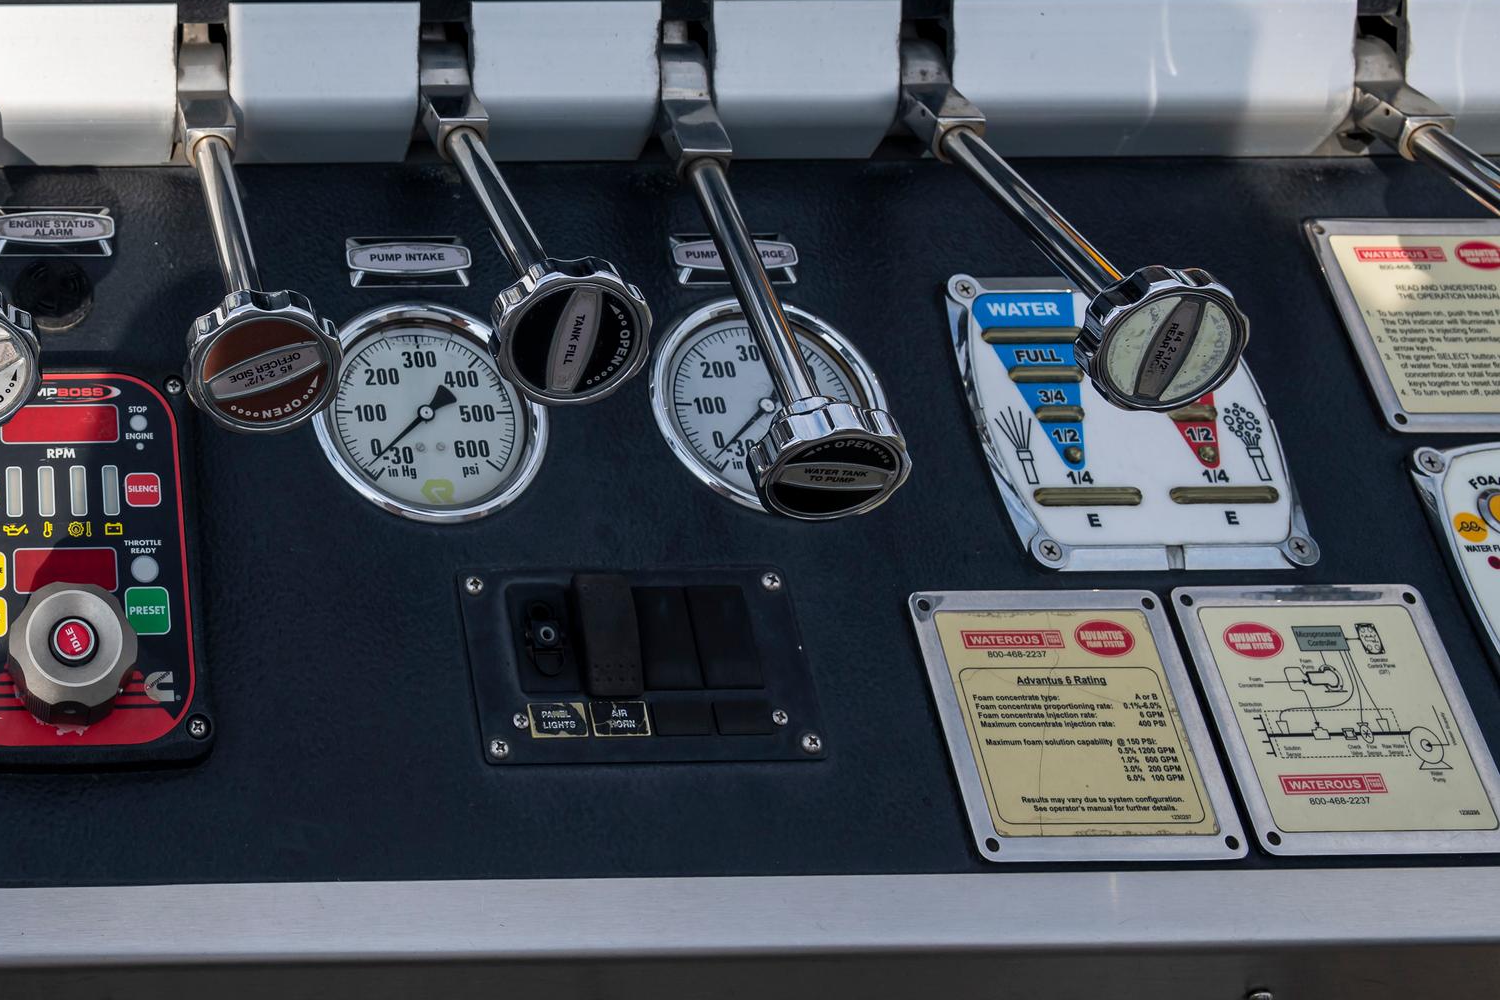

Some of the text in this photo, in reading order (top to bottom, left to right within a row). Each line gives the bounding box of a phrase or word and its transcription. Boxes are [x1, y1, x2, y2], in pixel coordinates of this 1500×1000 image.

[9, 220, 94, 228] ENGINE STATUS
[370, 253, 445, 262] PUMP INTAKE
[987, 302, 1060, 316] WATER
[563, 314, 585, 365] TANK FILL
[614, 330, 630, 366] OPEN
[403, 351, 436, 368] 300
[1015, 350, 1062, 362] FULL
[229, 353, 300, 383] OFFICER SIDE
[364, 368, 400, 386] 200
[444, 370, 478, 388] 400
[37, 387, 103, 397] MPBOSS
[1038, 390, 1065, 403] 3/4
[262, 399, 301, 418] OPEN
[354, 404, 386, 422] 100
[459, 404, 494, 422] 500
[1053, 429, 1079, 442] 1/2
[1186, 428, 1213, 441] 1/2
[454, 440, 490, 458] 600
[834, 440, 874, 450] OPEN
[47, 449, 75, 458] RPM
[1067, 471, 1093, 484] 1/4
[1202, 469, 1229, 483] 1/4
[128, 485, 158, 493] SILENCE
[129, 606, 165, 615] PRESET
[65, 627, 82, 652] IDLE
[970, 636, 1039, 644] WATEROUS
[1080, 631, 1124, 640] ADVANTUS
[1017, 676, 1107, 685] Advantus 6 Rating
[1289, 780, 1361, 789] WATEROUS
[1309, 797, 1370, 805] 800-468-2237
